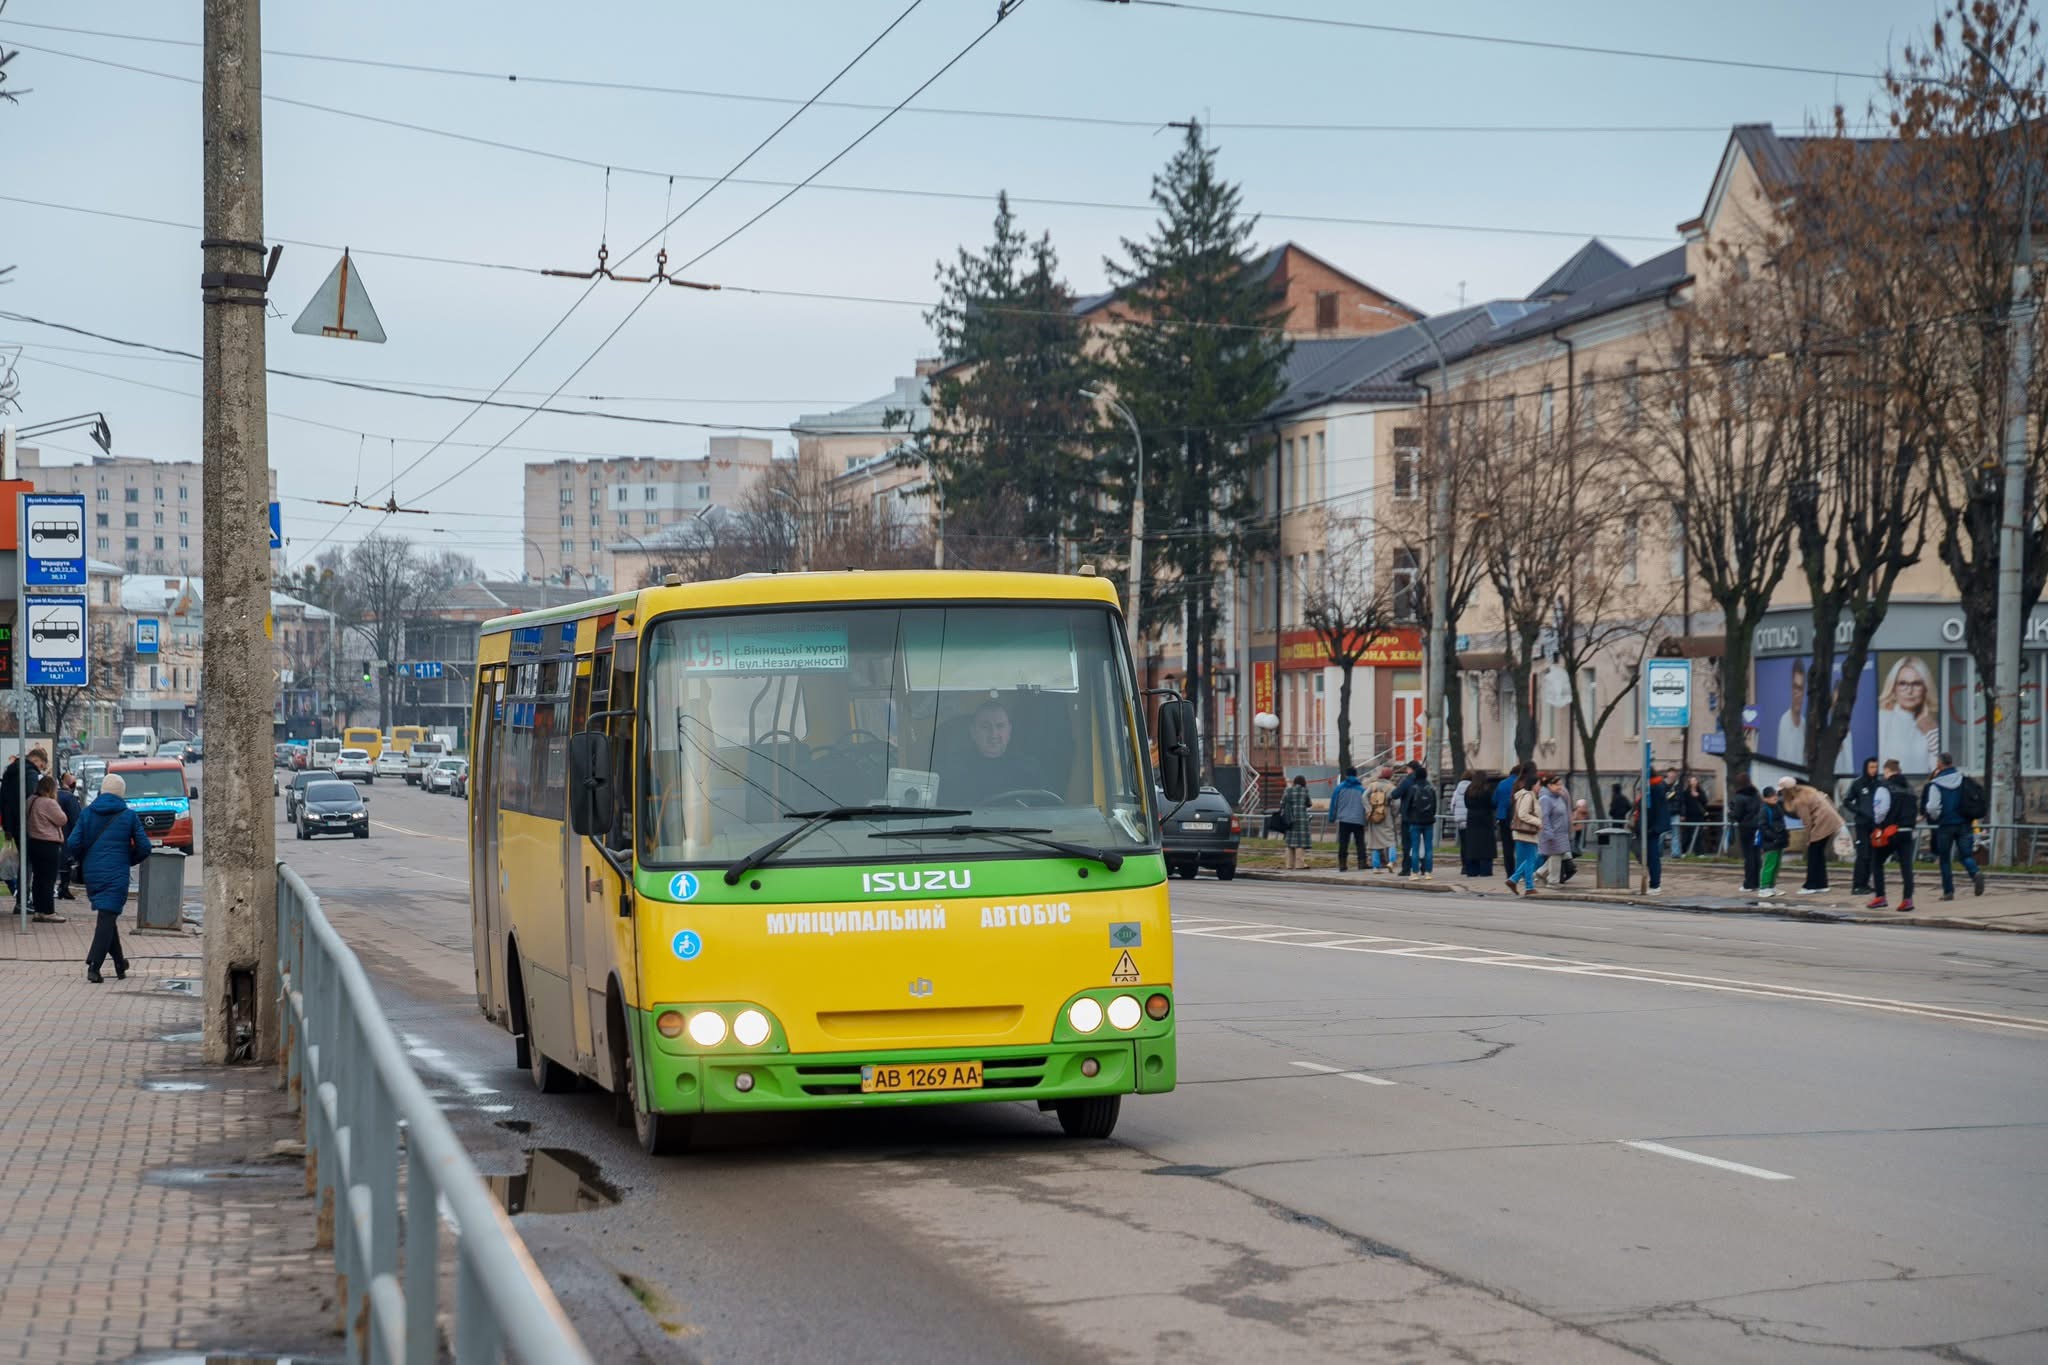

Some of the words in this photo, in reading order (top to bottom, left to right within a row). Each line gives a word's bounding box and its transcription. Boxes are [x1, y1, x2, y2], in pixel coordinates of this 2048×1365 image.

[734, 644, 803, 656] с.Вінницькі
[806, 643, 846, 656] хутори
[735, 656, 847, 670] (вул.Незалежності)
[862, 869, 971, 893] ISUZU
[766, 904, 946, 936] МУНІЦИПАЛЬНИЙ
[980, 902, 1072, 928] АВТОБУС
[907, 1068, 947, 1087] 1269
